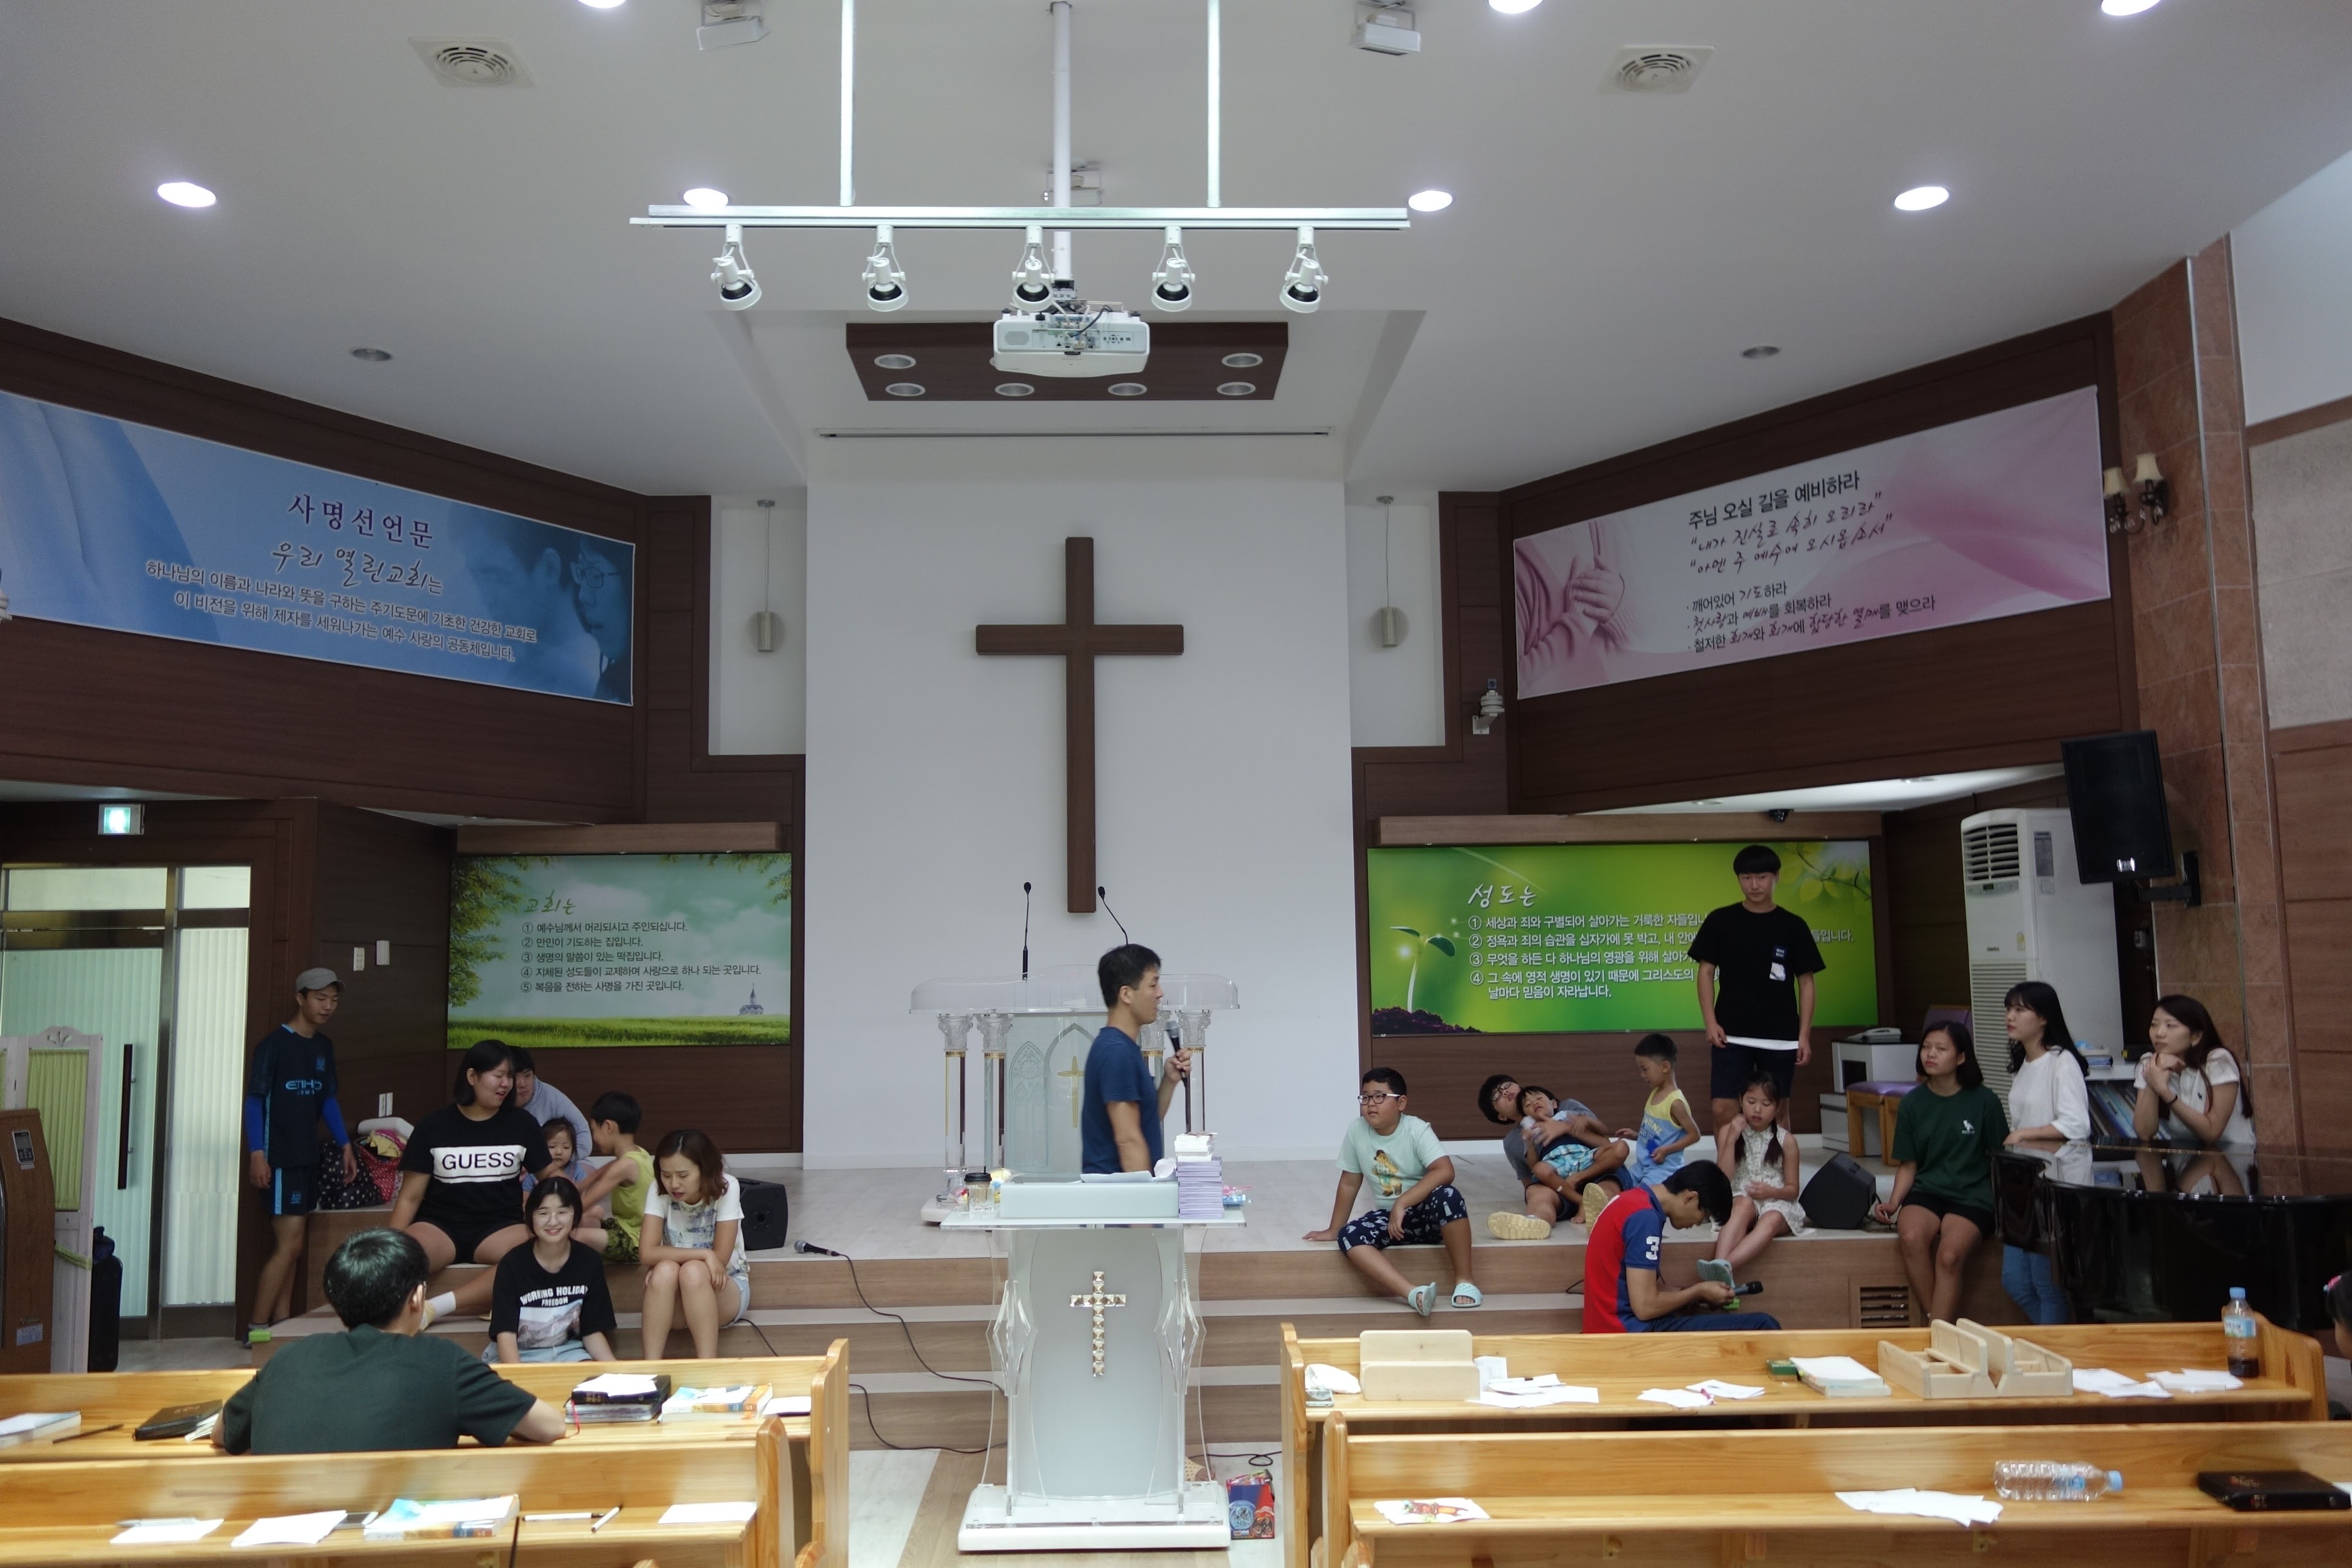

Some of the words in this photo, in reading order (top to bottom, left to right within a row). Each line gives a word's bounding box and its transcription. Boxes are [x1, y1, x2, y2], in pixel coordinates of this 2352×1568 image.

[1689, 506, 1717, 529] 주님
[1723, 497, 1753, 521] 오실
[1759, 489, 1789, 514] 길을
[1795, 470, 1860, 502] 예비하라
[288, 494, 433, 549] 사명선언문
[1733, 520, 1779, 549] 진실로
[1786, 509, 1817, 537] 속히
[272, 542, 323, 573] 우리
[336, 548, 443, 595] 열린교회는
[1734, 552, 1746, 574] 주
[147, 561, 204, 585] 하나님의
[210, 572, 251, 592] 이름과
[256, 581, 295, 601] 나라와
[300, 588, 325, 606] 뜻을
[330, 594, 366, 613] 구하는
[370, 601, 428, 624] 주기도문에
[433, 613, 466, 630] 기초한
[470, 619, 501, 637] 건강한
[505, 626, 537, 642] 교회로
[1693, 591, 1735, 612] 깨어있어
[1739, 581, 1788, 600] 기도하라
[1694, 611, 1738, 635] 첫사랑과
[1784, 592, 1832, 615] 회복하라
[1694, 633, 1726, 653] 철저한
[1730, 628, 1765, 644] 회개와
[1769, 620, 1805, 636] 회개에
[1809, 607, 1848, 635] 합당한
[1853, 603, 1891, 629] 열매를
[1896, 594, 1935, 617] 맺으라
[175, 592, 189, 608] 이
[195, 595, 237, 616] 비전을
[242, 603, 268, 621] 위해
[273, 609, 312, 627] 제자를
[317, 615, 377, 638] 세워나가는
[382, 627, 405, 642] 예수
[410, 631, 444, 650] 사랑의
[448, 637, 515, 661] 공동체입니다.
[524, 890, 576, 915] 교회는
[1468, 884, 1537, 908] 성도는
[537, 923, 581, 933] 예수님께서
[584, 922, 629, 932] 머리되시고
[632, 921, 688, 932] 주인되십니다.
[1486, 916, 1517, 929] 세상과
[1520, 916, 1541, 929] 죄와
[1544, 915, 1585, 928] 구별되어
[1589, 914, 1630, 927] 살아가는
[1633, 913, 1664, 927] 거룩한
[1667, 913, 1708, 926] 자들입니
[537, 938, 563, 947] 만민이
[566, 938, 602, 947] 기도하는
[606, 936, 643, 947] 집입니다.
[1487, 934, 1518, 947] 정욕과
[1521, 934, 1541, 947] 죄의
[1544, 933, 1576, 947] 습관을
[1579, 933, 1620, 946] 십자가에
[1624, 932, 1634, 946] 못
[1637, 932, 1661, 946] 박고,
[1664, 932, 1674, 945] 내
[1811, 929, 1854, 942] 들입니다.
[537, 952, 563, 962] 생명의
[566, 952, 593, 962] 말씀이
[596, 952, 614, 962] 있는
[617, 951, 664, 961] 떡집입니다.
[1487, 953, 1518, 966] 무엇을
[1521, 953, 1543, 965] 하든
[1546, 952, 1556, 965] 다
[1559, 952, 1601, 965] 하나님의
[1604, 950, 1635, 964] 영광을
[1638, 950, 1659, 964] 위해
[536, 967, 563, 978] 지체된
[566, 967, 601, 977] 성도들이
[604, 967, 639, 976] 교제하며
[642, 966, 679, 976] 사랑으로
[682, 965, 700, 975] 하나
[702, 965, 720, 975] 되는
[723, 965, 761, 975] 곳입니다.
[1488, 973, 1499, 984] 그
[1501, 972, 1523, 984] 속에
[1526, 971, 1546, 984] 영적
[1550, 970, 1581, 984] 생명이
[1584, 970, 1604, 982] 있기
[1609, 969, 1639, 982] 때문에
[1642, 969, 1694, 981] 그리스도의
[535, 982, 563, 992] 복음을
[565, 982, 592, 991] 전하는
[595, 981, 622, 991] 사명을
[626, 981, 643, 991] 가진
[645, 980, 684, 990] 곳입니다.
[1489, 987, 1520, 1000] 날마다
[1523, 985, 1553, 999] 믿음이
[1557, 985, 1612, 998] 자라납니다.
[442, 1152, 515, 1170] GUESS
[1645, 1236, 1660, 1260] 3
[520, 1288, 554, 1305] WORKING
[541, 1296, 569, 1307] FREEDOM
